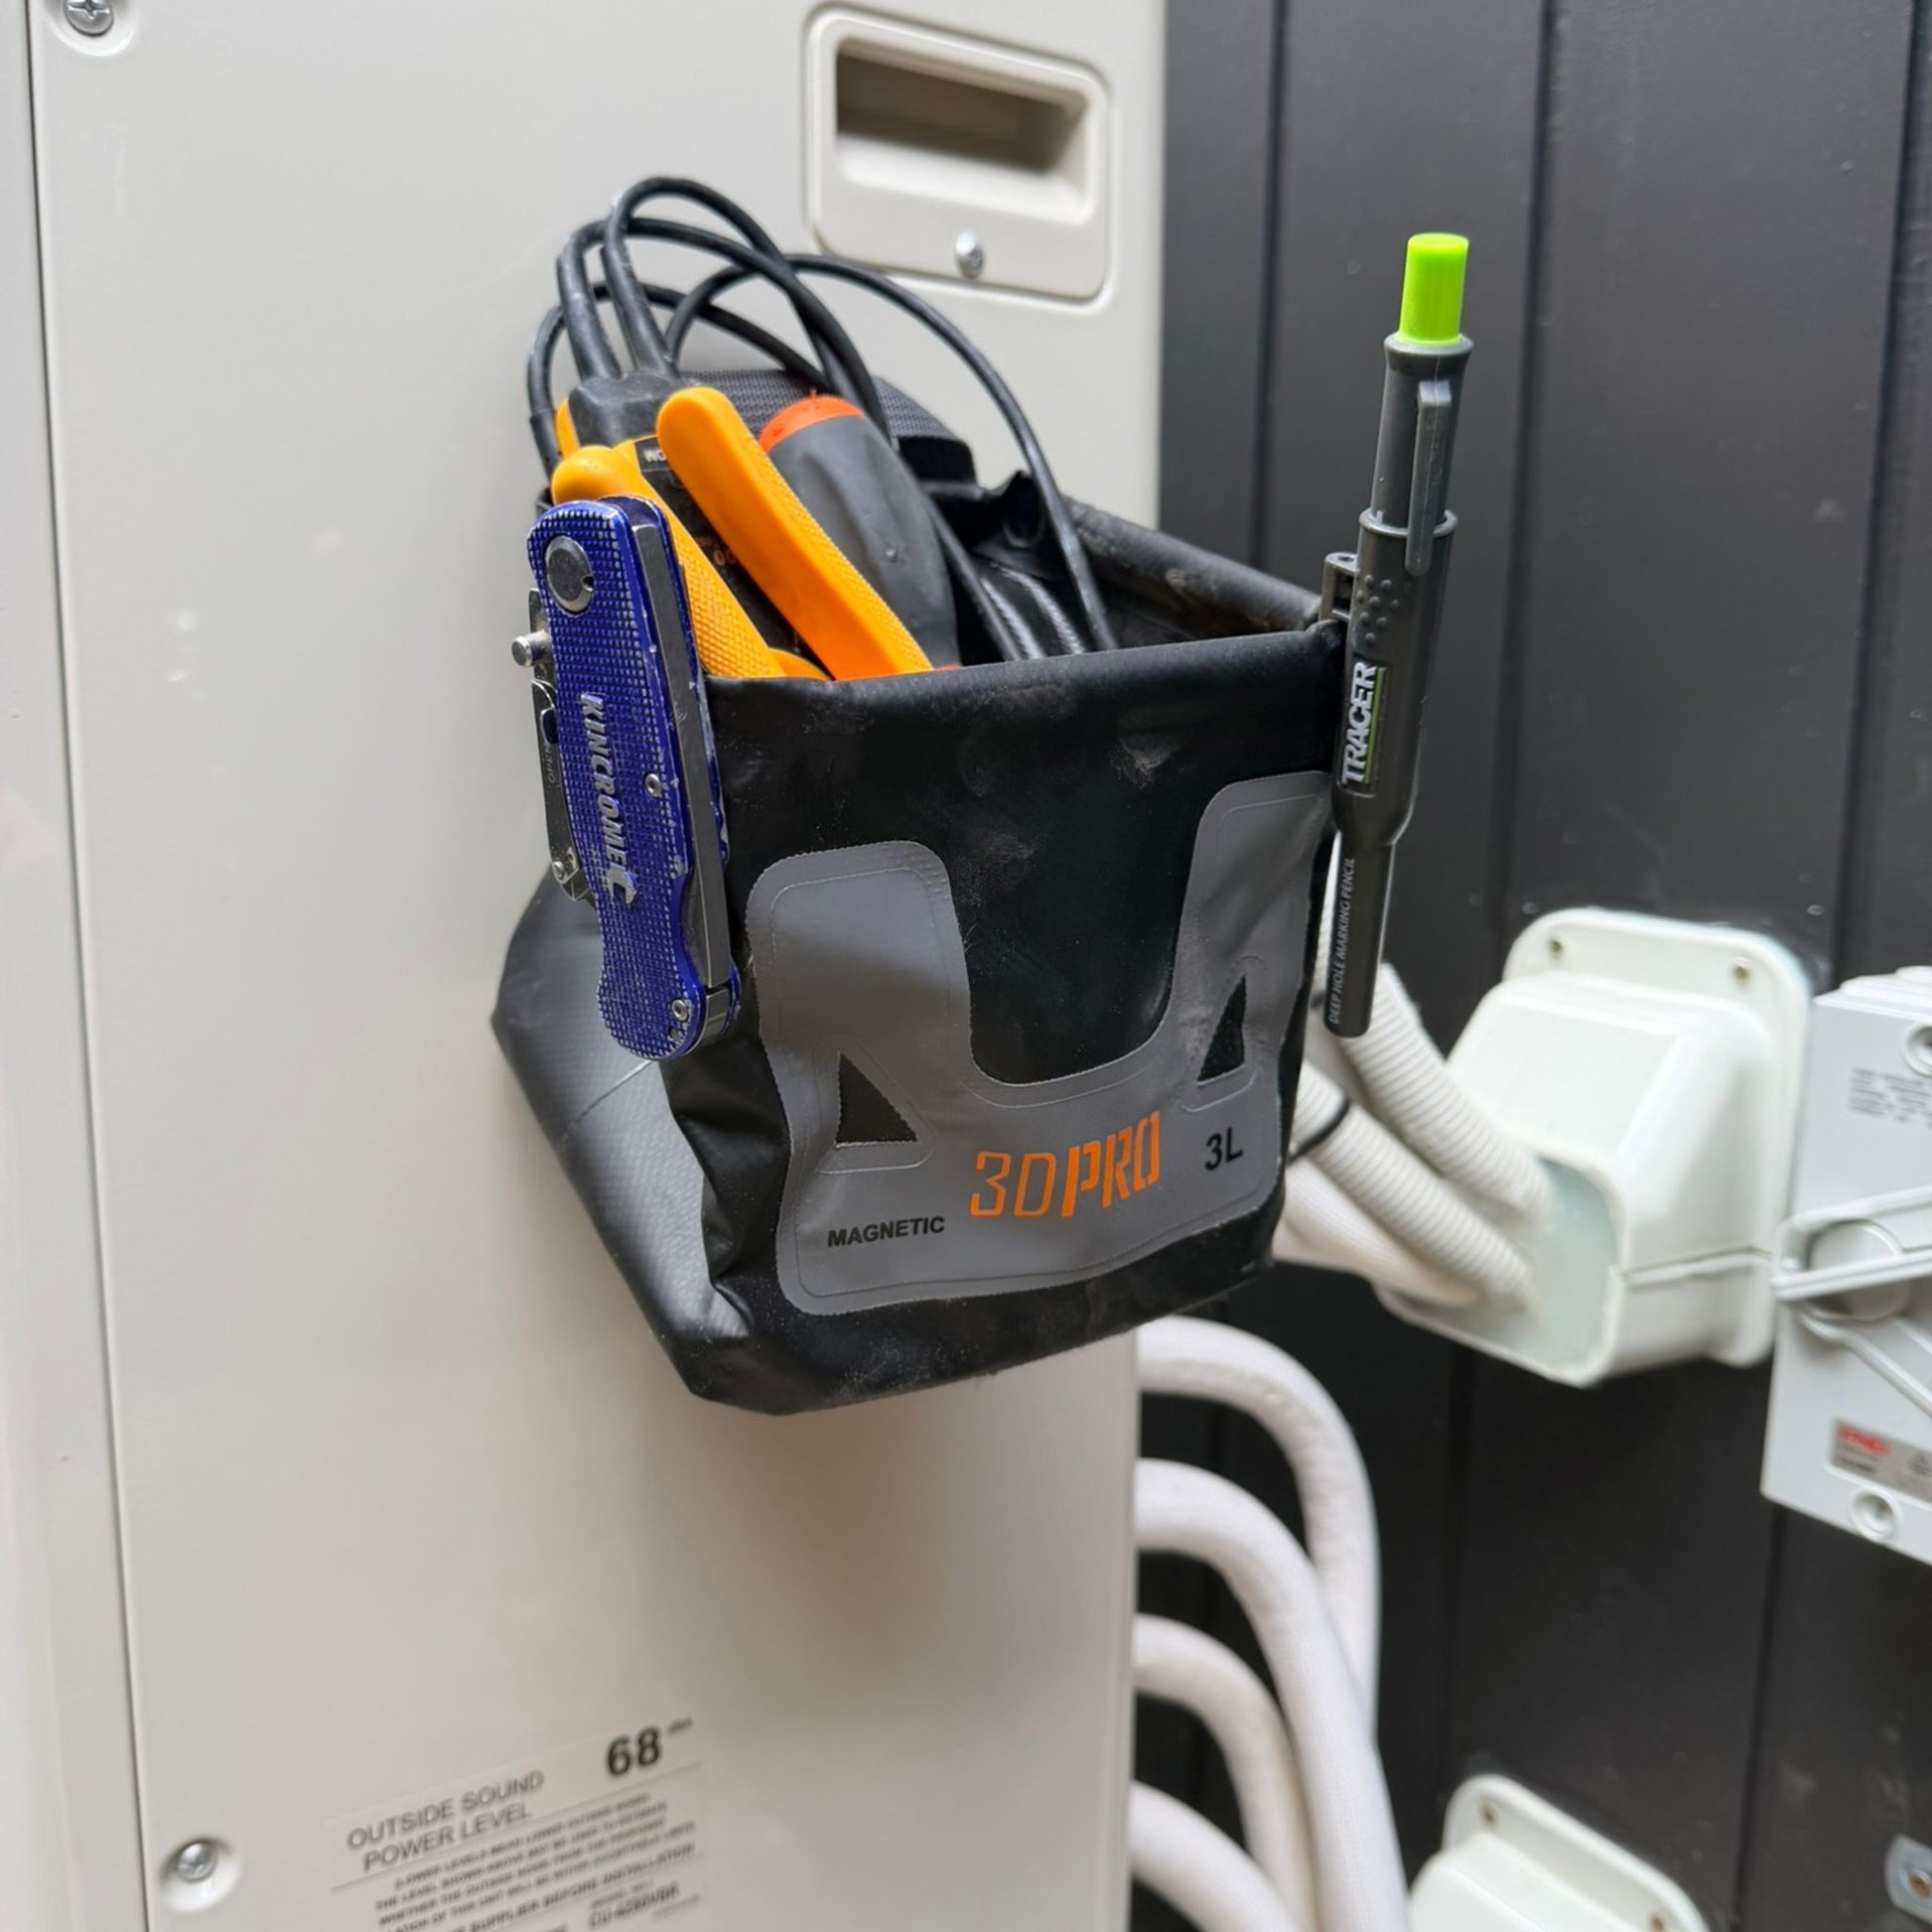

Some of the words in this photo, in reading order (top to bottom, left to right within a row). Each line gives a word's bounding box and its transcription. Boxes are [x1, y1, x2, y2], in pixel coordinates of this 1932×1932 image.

[1340, 661, 1378, 784] TRACER
[579, 694, 628, 866] KINCROME
[1341, 858, 1356, 898] PENCIL
[1334, 900, 1351, 960] MARKING
[1331, 959, 1346, 994] HOLE
[1327, 994, 1341, 1025] DEEP
[1204, 1127, 1244, 1172] 3L
[827, 1216, 945, 1248] MAGNETIC
[606, 1725, 662, 1777] 68
[347, 1798, 454, 1850] OUTSIDE
[462, 1770, 545, 1814] SOUND
[362, 1825, 456, 1872] POWER
[460, 1801, 530, 1840] LEVEL
